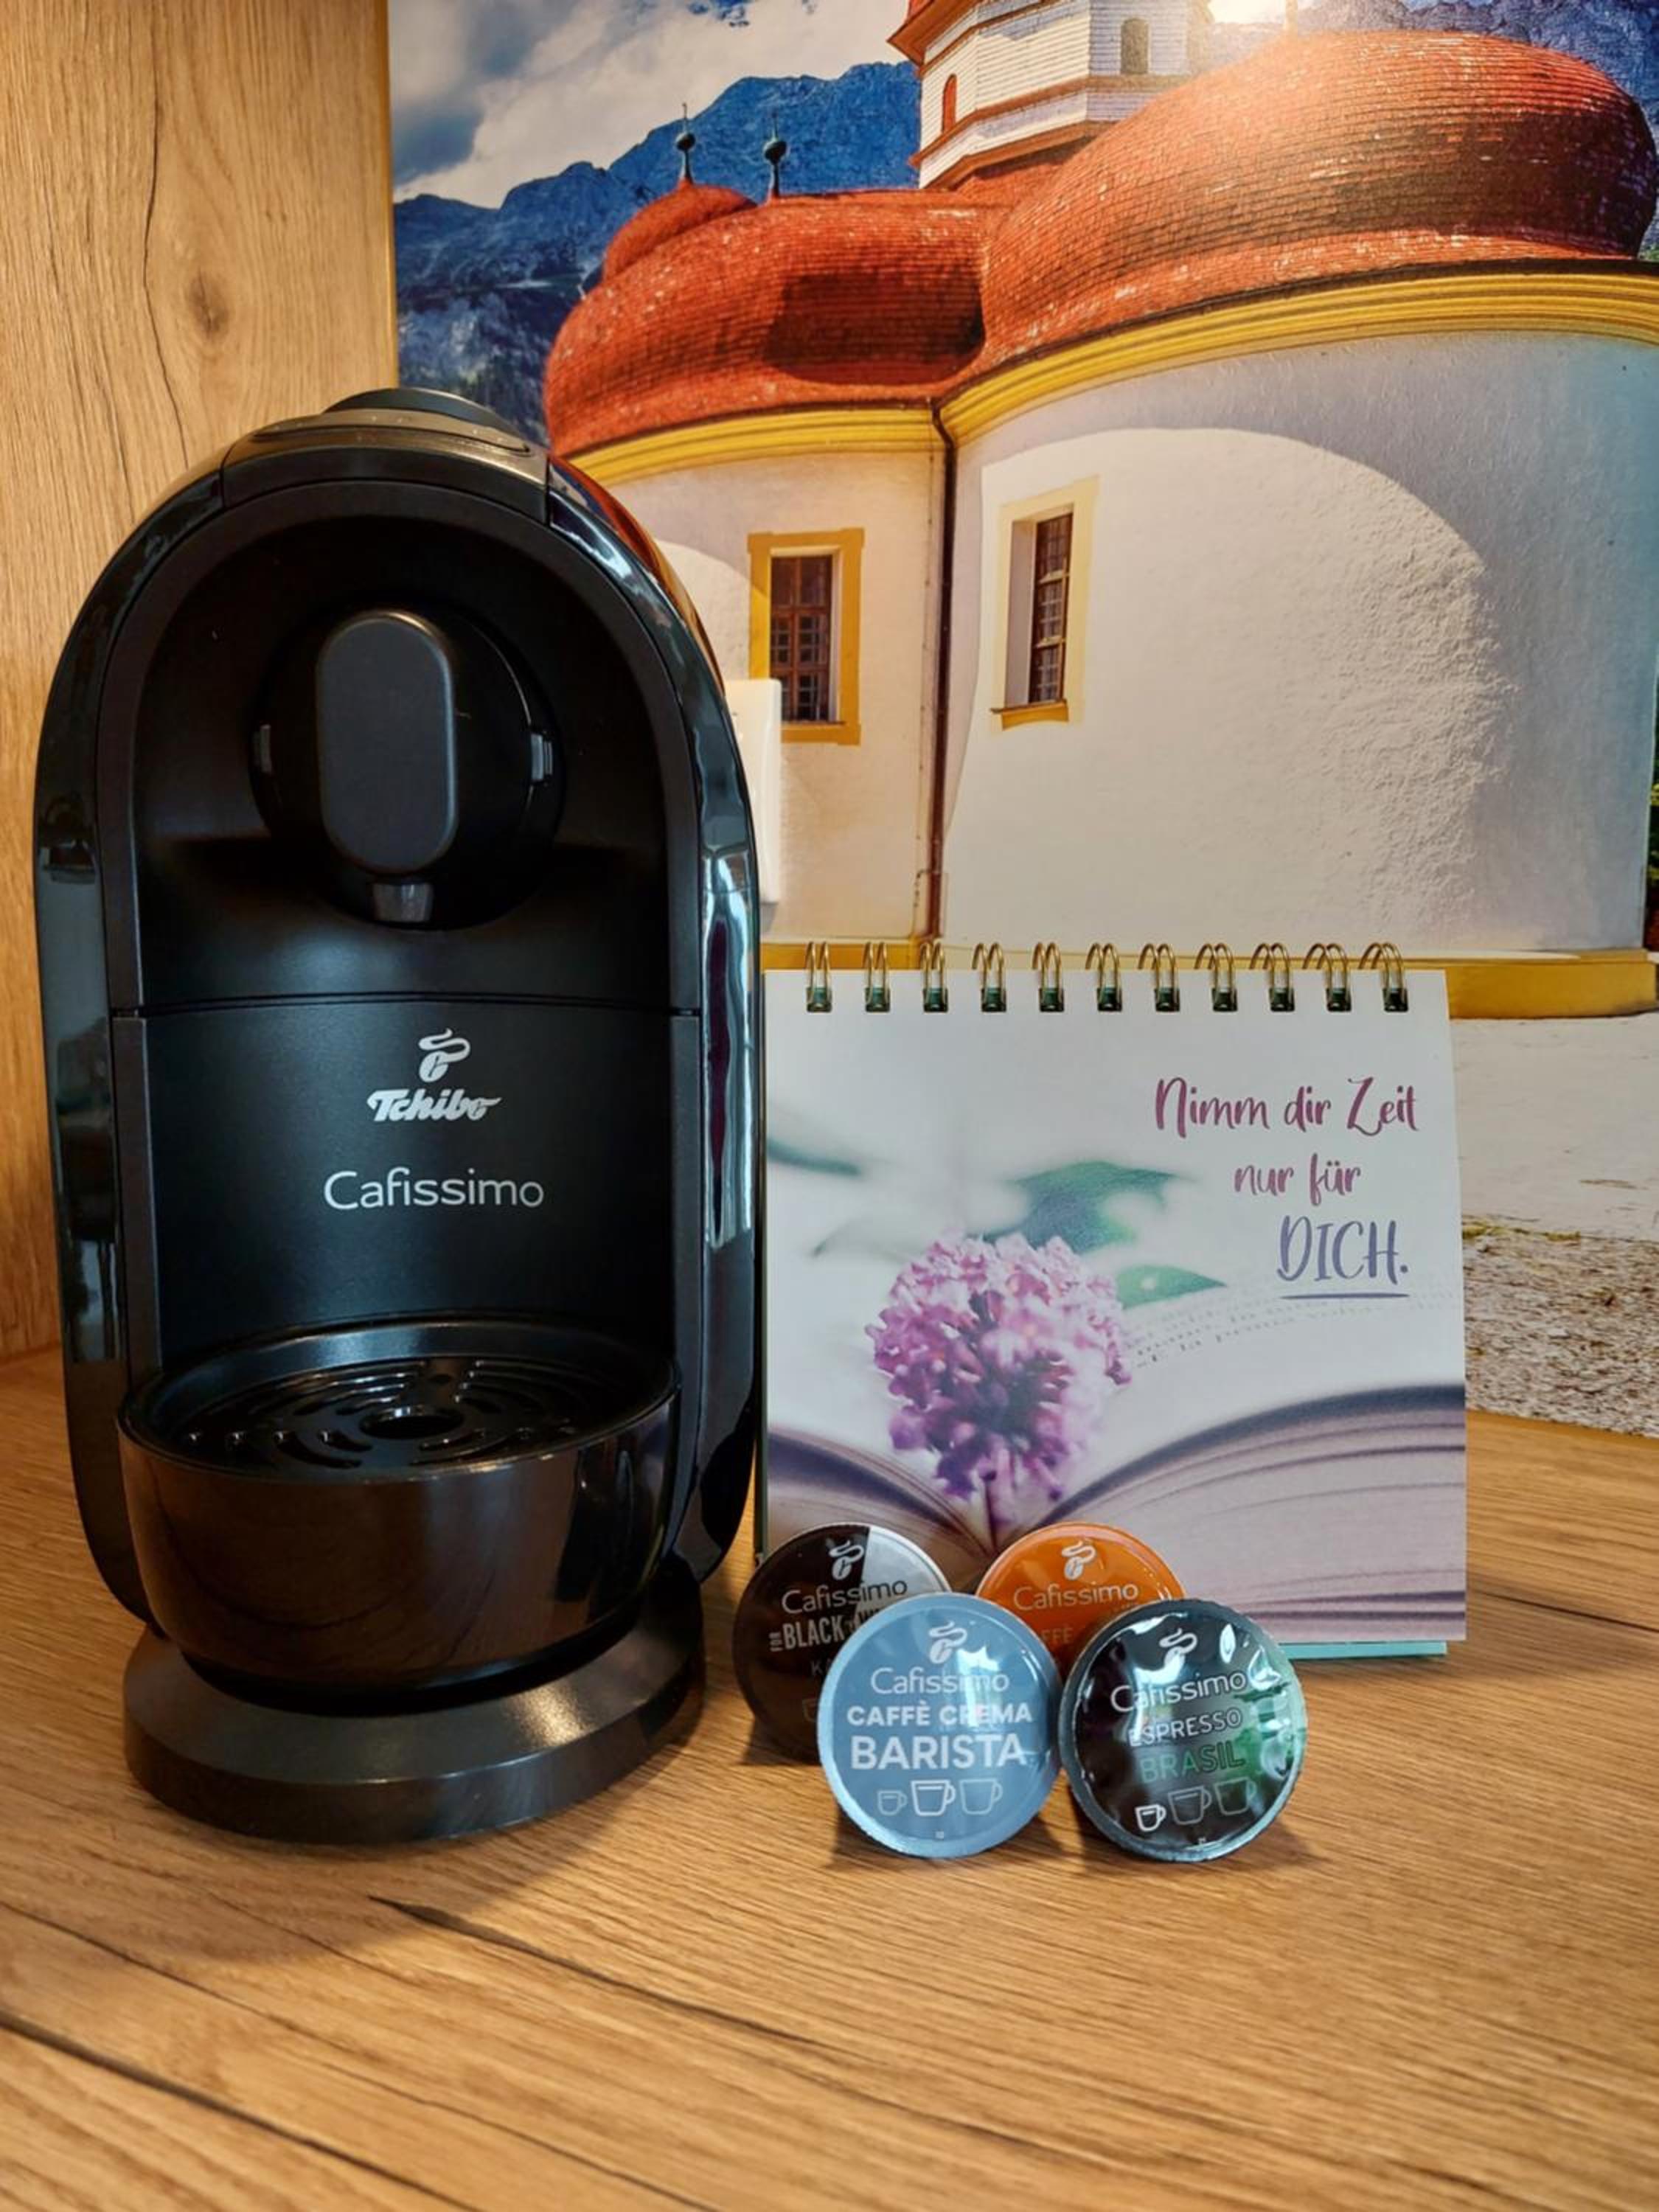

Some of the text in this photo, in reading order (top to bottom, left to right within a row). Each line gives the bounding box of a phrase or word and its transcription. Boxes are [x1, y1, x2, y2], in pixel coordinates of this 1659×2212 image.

[366, 1088, 503, 1122] Tchibo
[1155, 1077, 1419, 1139] Nimm dir Zeit
[324, 1166, 544, 1210] Cafissimo
[1234, 1152, 1362, 1207] nur für
[1276, 1215, 1409, 1286] DICH.
[781, 1579, 908, 1615] Cafissimo
[1012, 1582, 1139, 1612] Cafissimo
[782, 1615, 845, 1651] BLACK
[870, 1666, 1009, 1695] Cafissimo
[1110, 1671, 1247, 1713] Cafissimo
[846, 1700, 1033, 1728] CAFFÈ CREMA
[1128, 1708, 1243, 1747] ESPRESSO
[849, 1733, 1027, 1770] BARISTA
[1138, 1739, 1246, 1784] BRASIL
